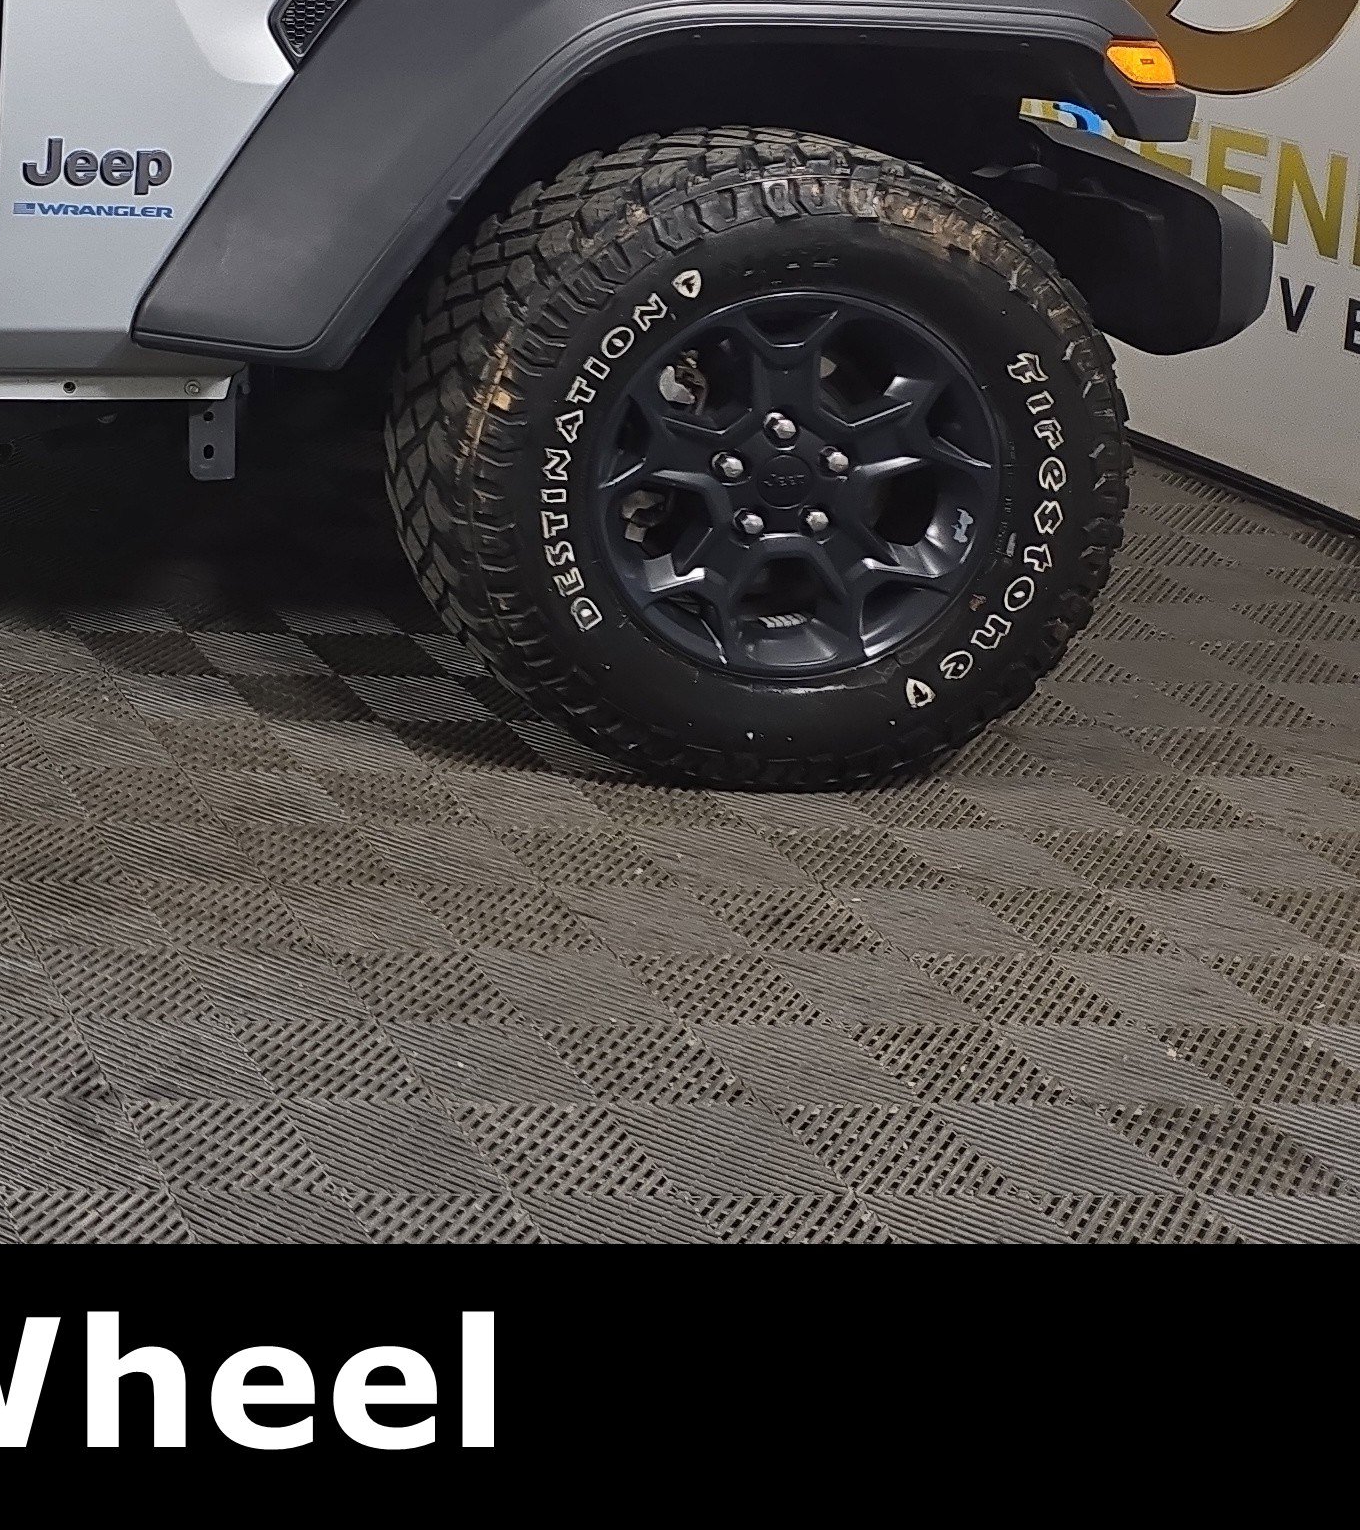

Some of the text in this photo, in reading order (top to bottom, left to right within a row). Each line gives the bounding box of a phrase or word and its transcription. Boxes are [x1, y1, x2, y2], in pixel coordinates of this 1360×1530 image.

[22, 137, 173, 196] Jeep
[37, 202, 174, 219] WRANGLER
[541, 293, 669, 632] DESTINATION
[938, 351, 1067, 682] Firestone
